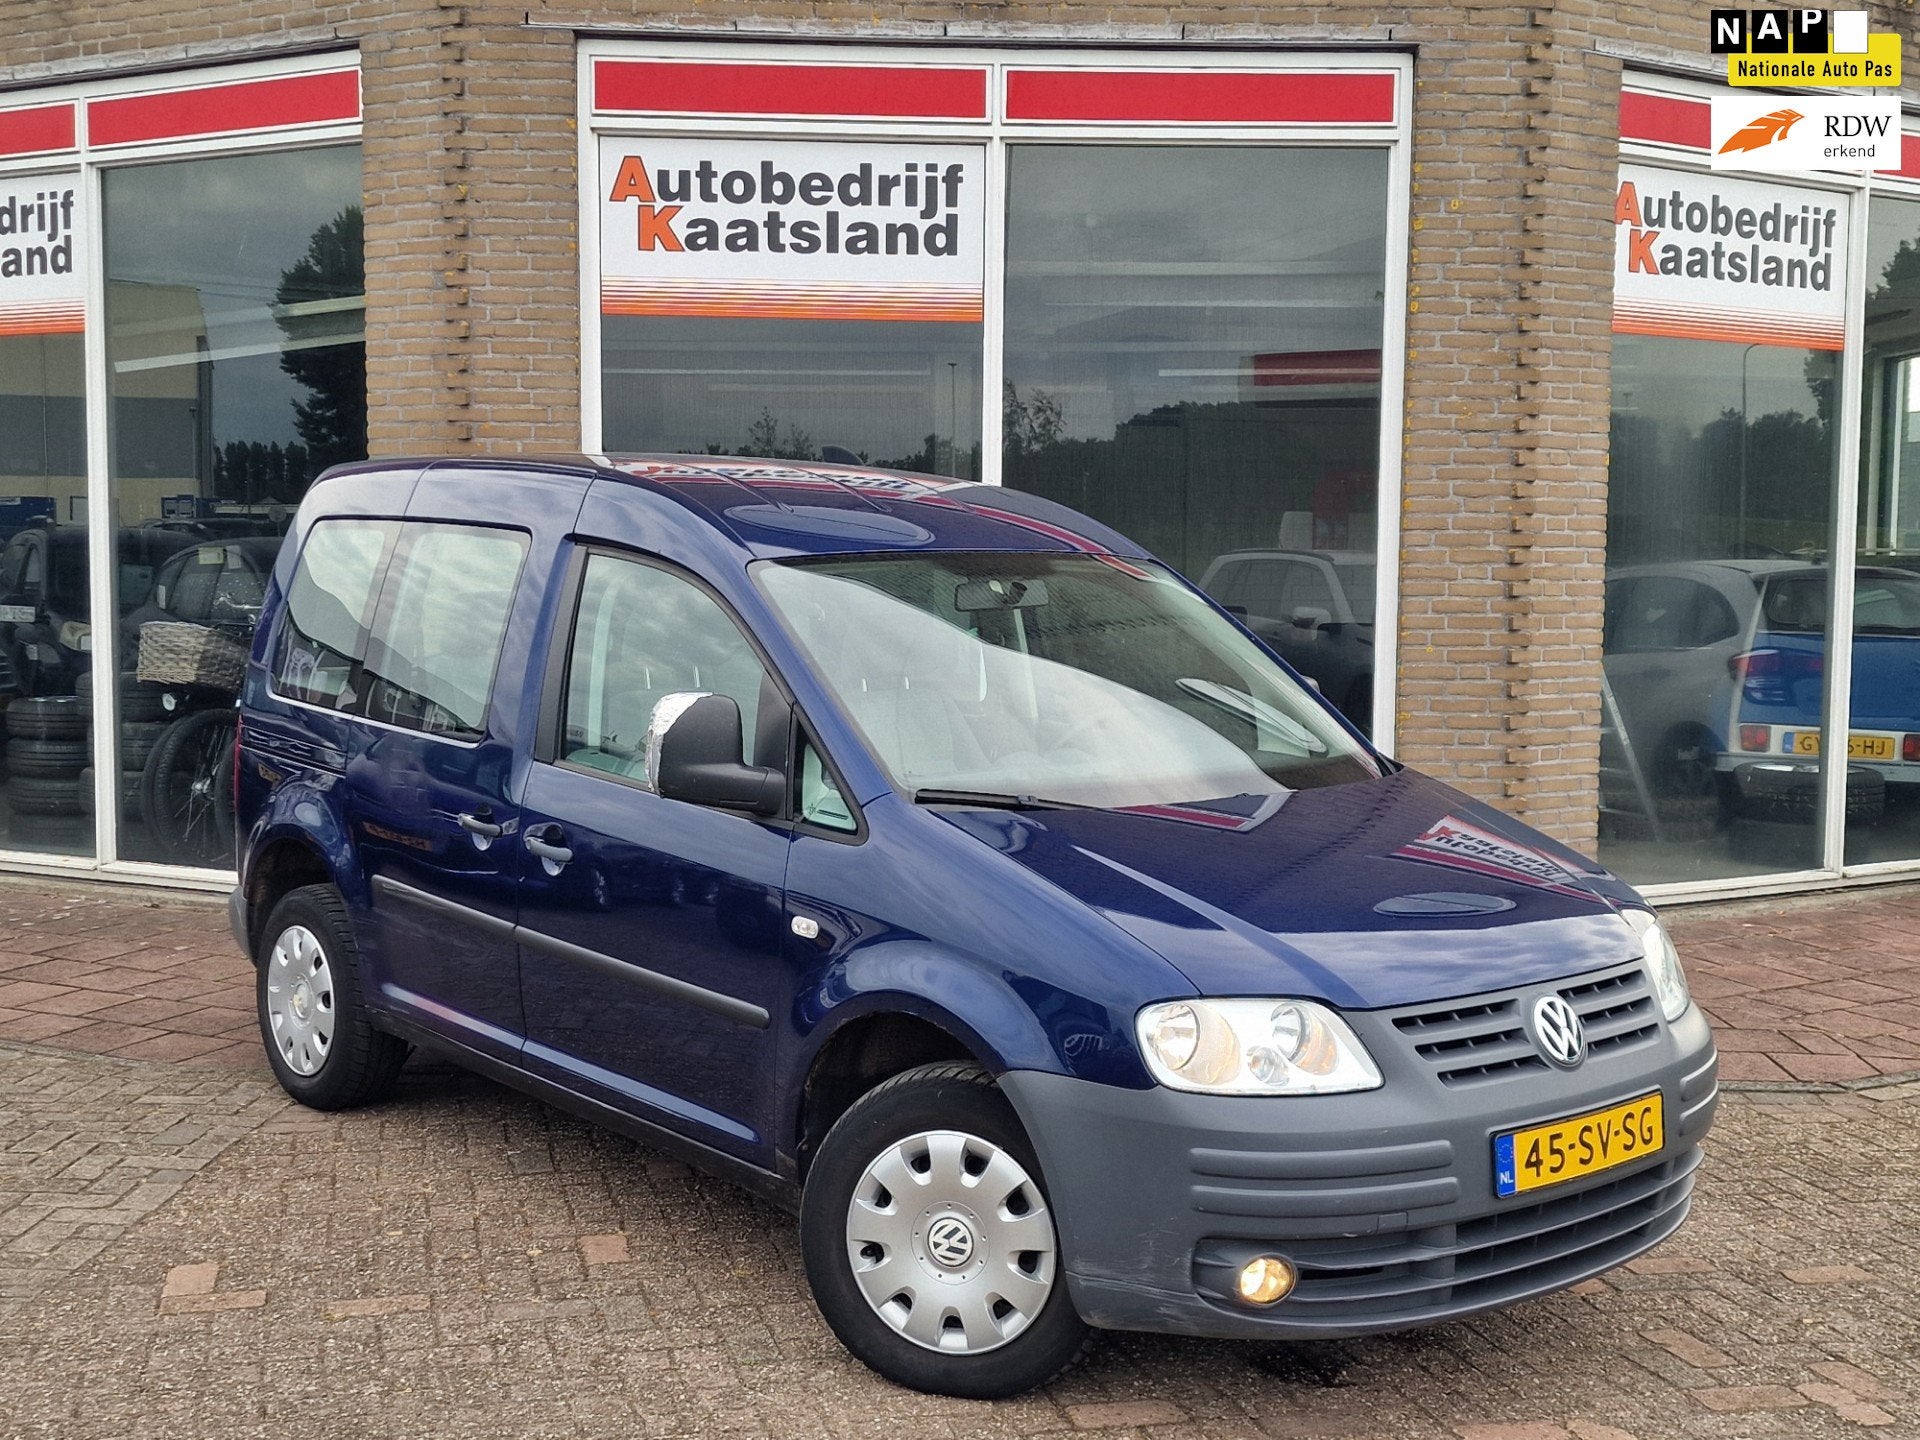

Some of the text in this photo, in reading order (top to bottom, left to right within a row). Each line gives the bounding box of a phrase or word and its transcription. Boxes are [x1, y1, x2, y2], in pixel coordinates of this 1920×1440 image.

[609, 155, 963, 219] Autobedrijf
[637, 204, 958, 256] Kaatsland
[1615, 181, 1836, 257] Autobedrijf
[1629, 229, 1831, 291] Kaatsland
[1524, 1106, 1653, 1178] 45-SV-SG
[1500, 1171, 1514, 1184] NL
